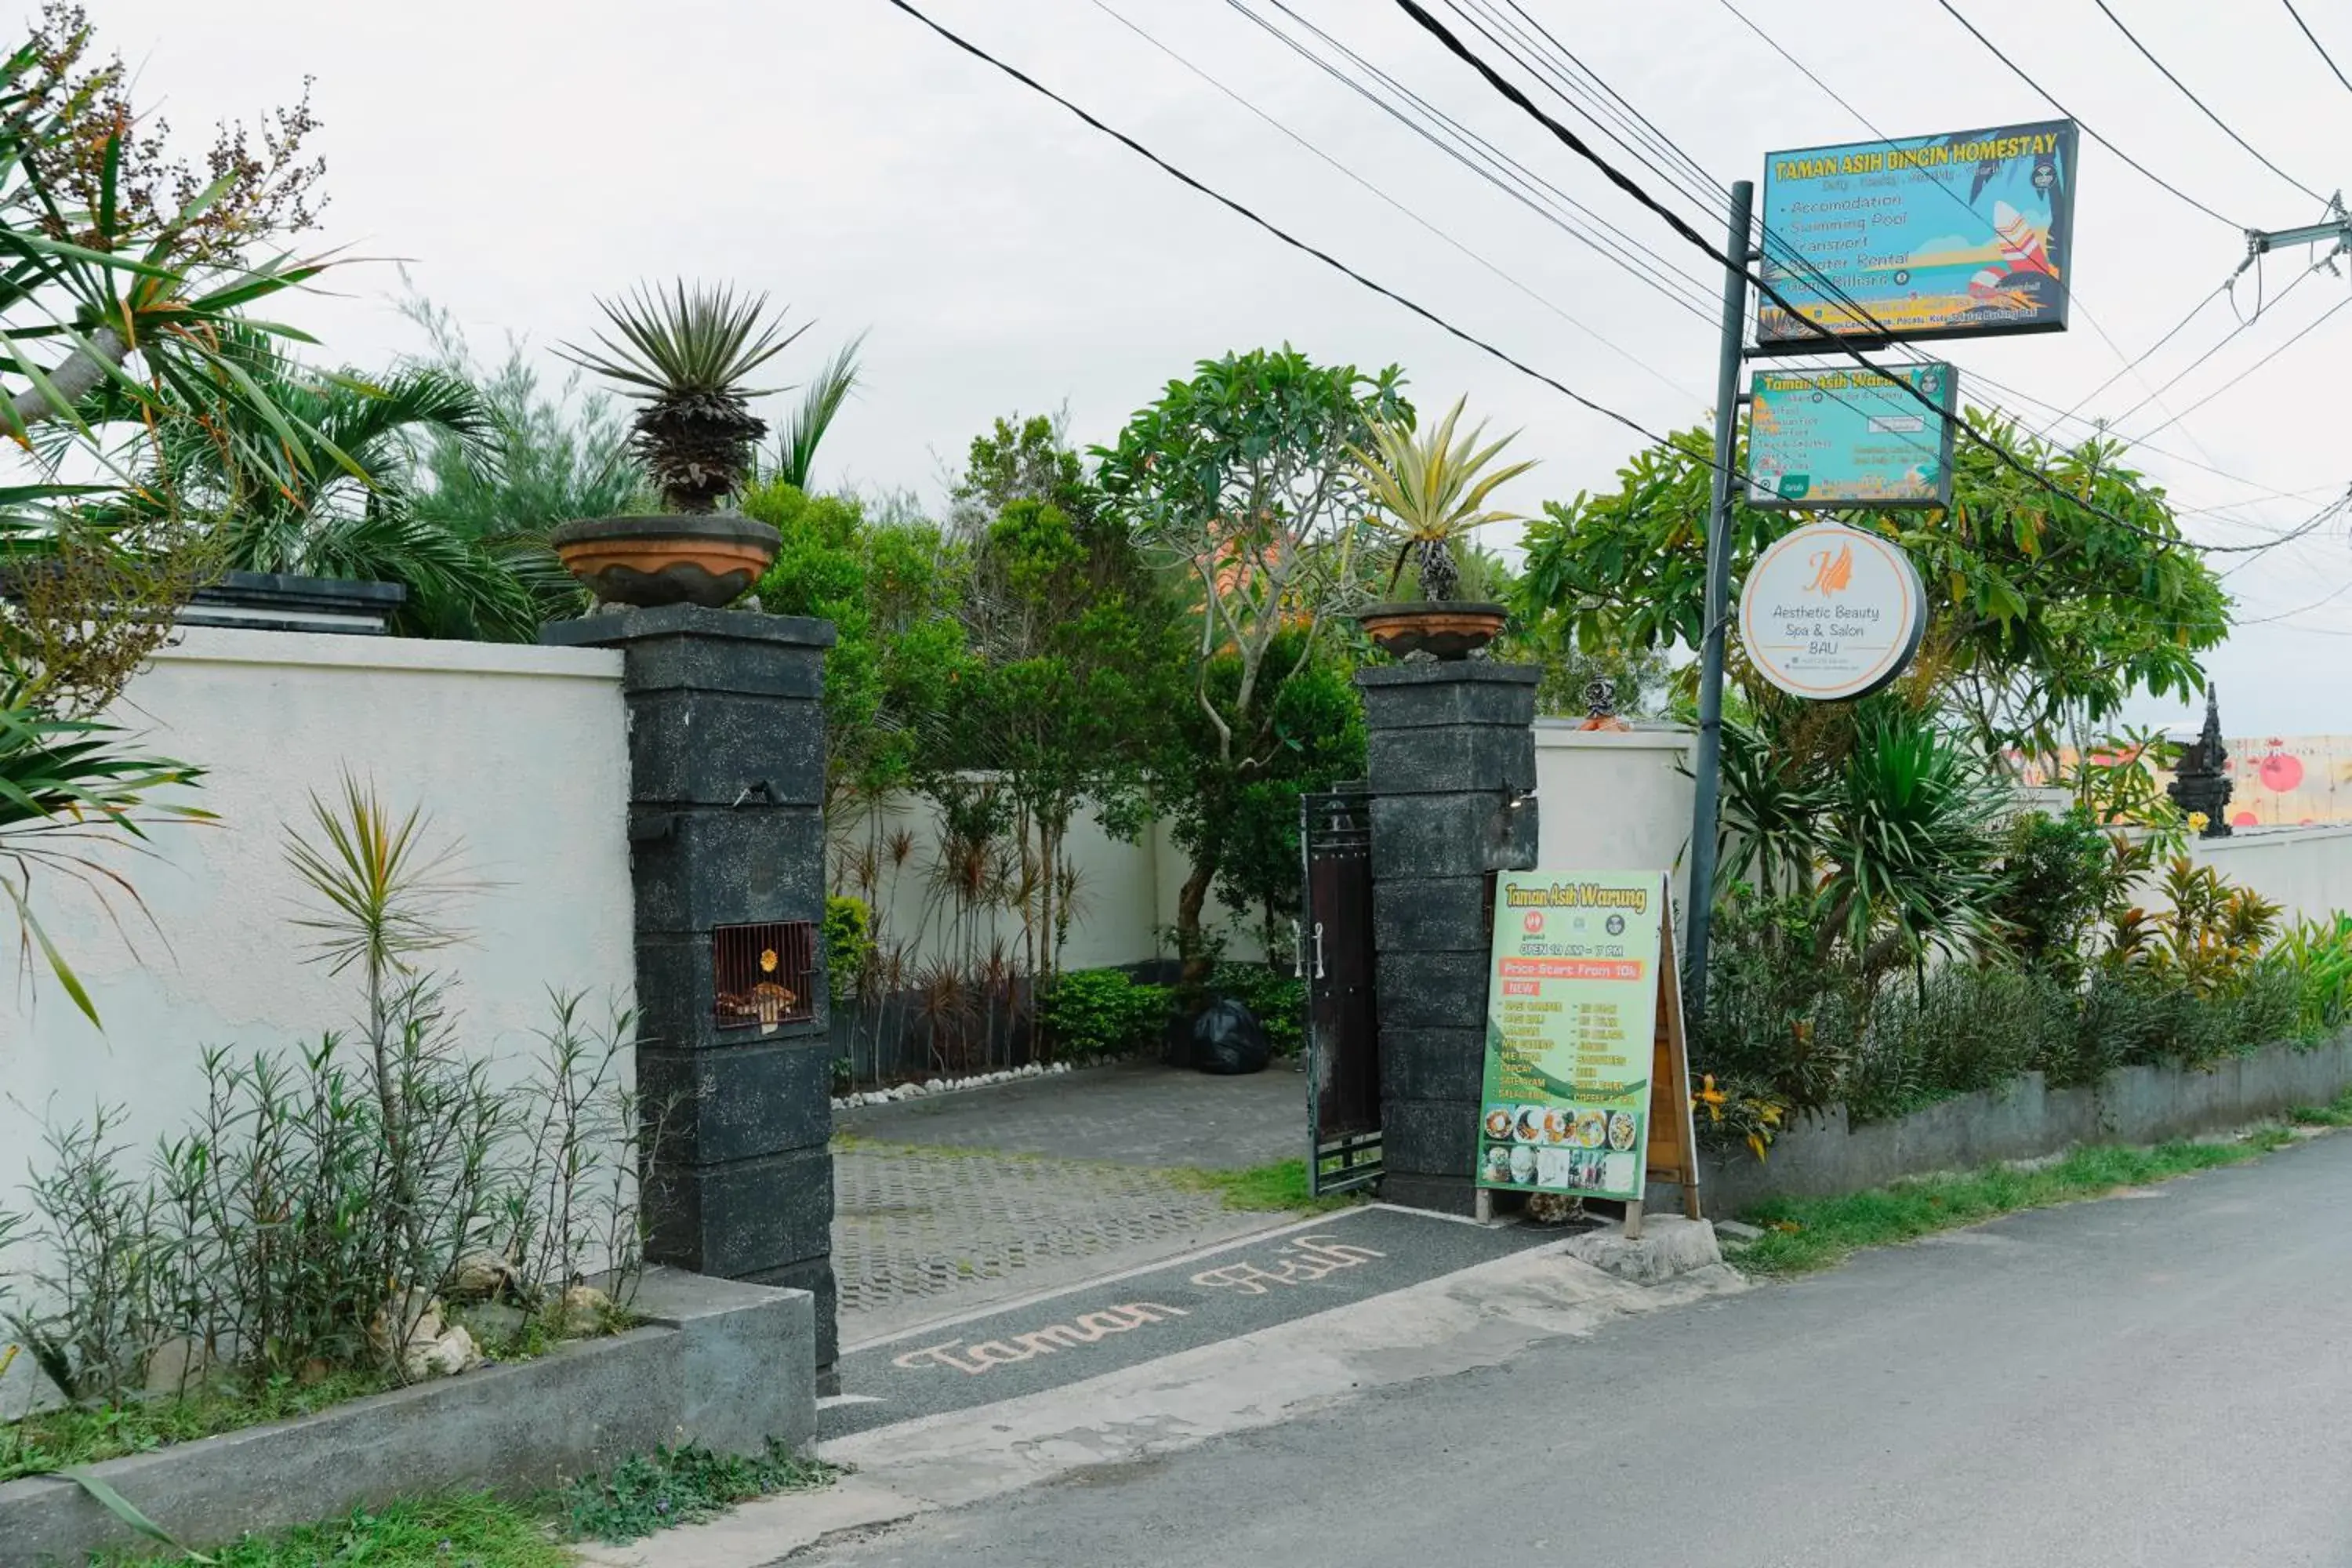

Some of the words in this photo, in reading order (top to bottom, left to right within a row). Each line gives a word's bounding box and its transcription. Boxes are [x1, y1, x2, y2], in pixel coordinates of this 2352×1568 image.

[1775, 158, 1838, 182] TAMAN
[1841, 151, 1883, 173] ASIH
[1951, 132, 2059, 163] HOMESTAY
[1791, 194, 1901, 213] Accomodation
[1871, 212, 1907, 227] Pool
[1857, 251, 1910, 268] Rental
[1766, 376, 1814, 390] Taman
[1816, 372, 1848, 389] Asih
[1850, 370, 1911, 390] Warug
[1773, 604, 1831, 619] Aesthetic
[1835, 605, 1880, 622] Beauty
[1785, 624, 1809, 639] Spa
[1813, 624, 1824, 637] &
[1829, 624, 1864, 637] Salon
[1506, 883, 1548, 908] Taman
[1550, 883, 1579, 909] Asih
[1579, 883, 1647, 914] Warung
[1519, 943, 1548, 956] OPEN
[1605, 945, 1624, 957] PM
[1538, 964, 1570, 975] Start
[1578, 965, 1610, 977] From
[1508, 982, 1534, 995] NEW
[892, 1300, 1191, 1375] Taman
